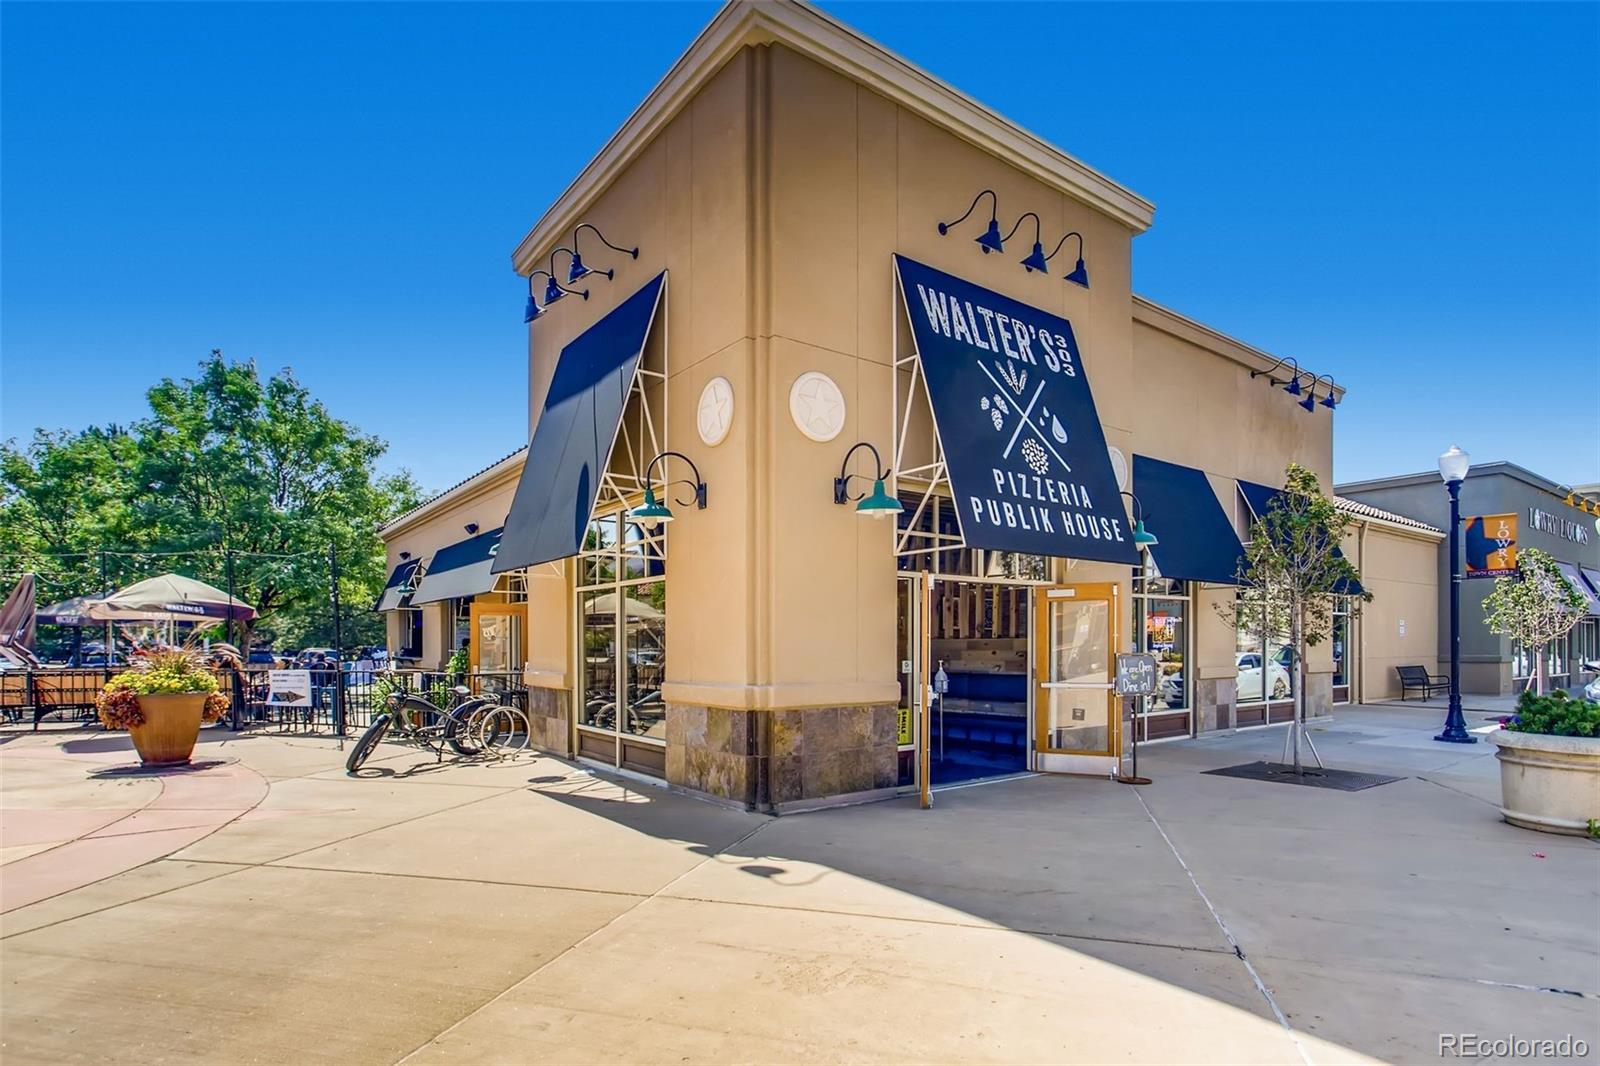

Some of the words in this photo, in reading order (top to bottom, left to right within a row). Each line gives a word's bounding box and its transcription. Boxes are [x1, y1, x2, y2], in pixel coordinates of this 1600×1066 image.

[917, 283, 1061, 373] WALTER'S
[992, 468, 1093, 509] PIZZERIA
[970, 496, 1055, 533] PUBLIK
[1061, 511, 1124, 542] HOUSE
[1495, 520, 1511, 567] LOWRY
